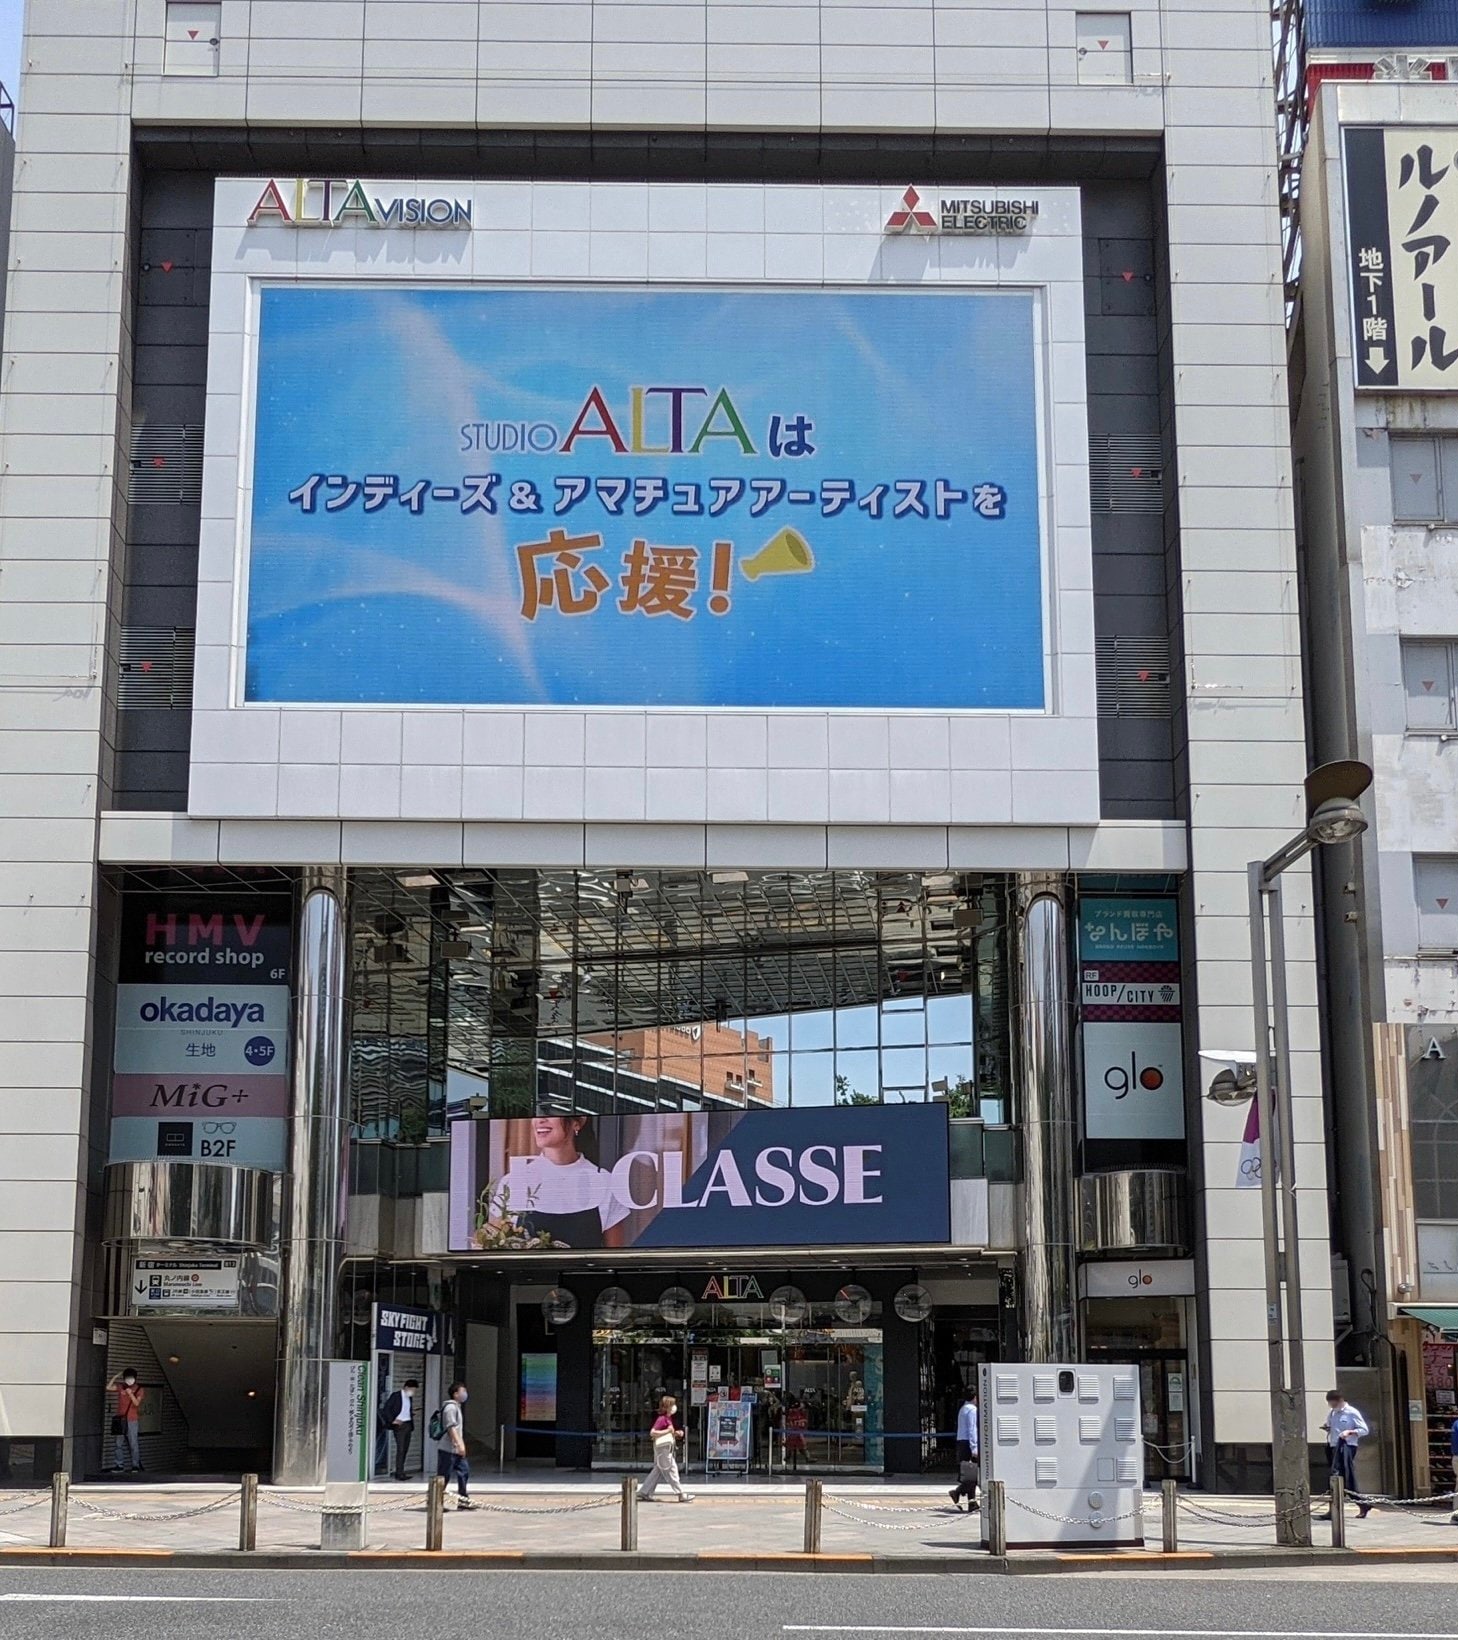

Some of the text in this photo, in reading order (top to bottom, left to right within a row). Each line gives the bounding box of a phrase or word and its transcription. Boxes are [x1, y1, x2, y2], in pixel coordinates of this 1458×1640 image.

[941, 200, 1039, 215] MITSUBISHI
[941, 215, 1027, 230] ELECTRIC
[1358, 247, 1388, 341] 地下1階
[768, 415, 815, 459] は
[289, 473, 1005, 519] インディーズ & アマチュアアーティストを
[145, 913, 265, 945] HMV
[1085, 922, 1174, 942] なんぼや
[145, 948, 265, 968] record shop
[270, 969, 286, 979] 6F
[1085, 971, 1098, 980] RF
[140, 996, 265, 1028] okadaya
[185, 1043, 216, 1058] 生地
[200, 1140, 236, 1157] B2F
[611, 1145, 884, 1210] CLASSE
[701, 1275, 764, 1299] ALTA
[1128, 1269, 1153, 1289] glo
[393, 1331, 426, 1349] STORE
